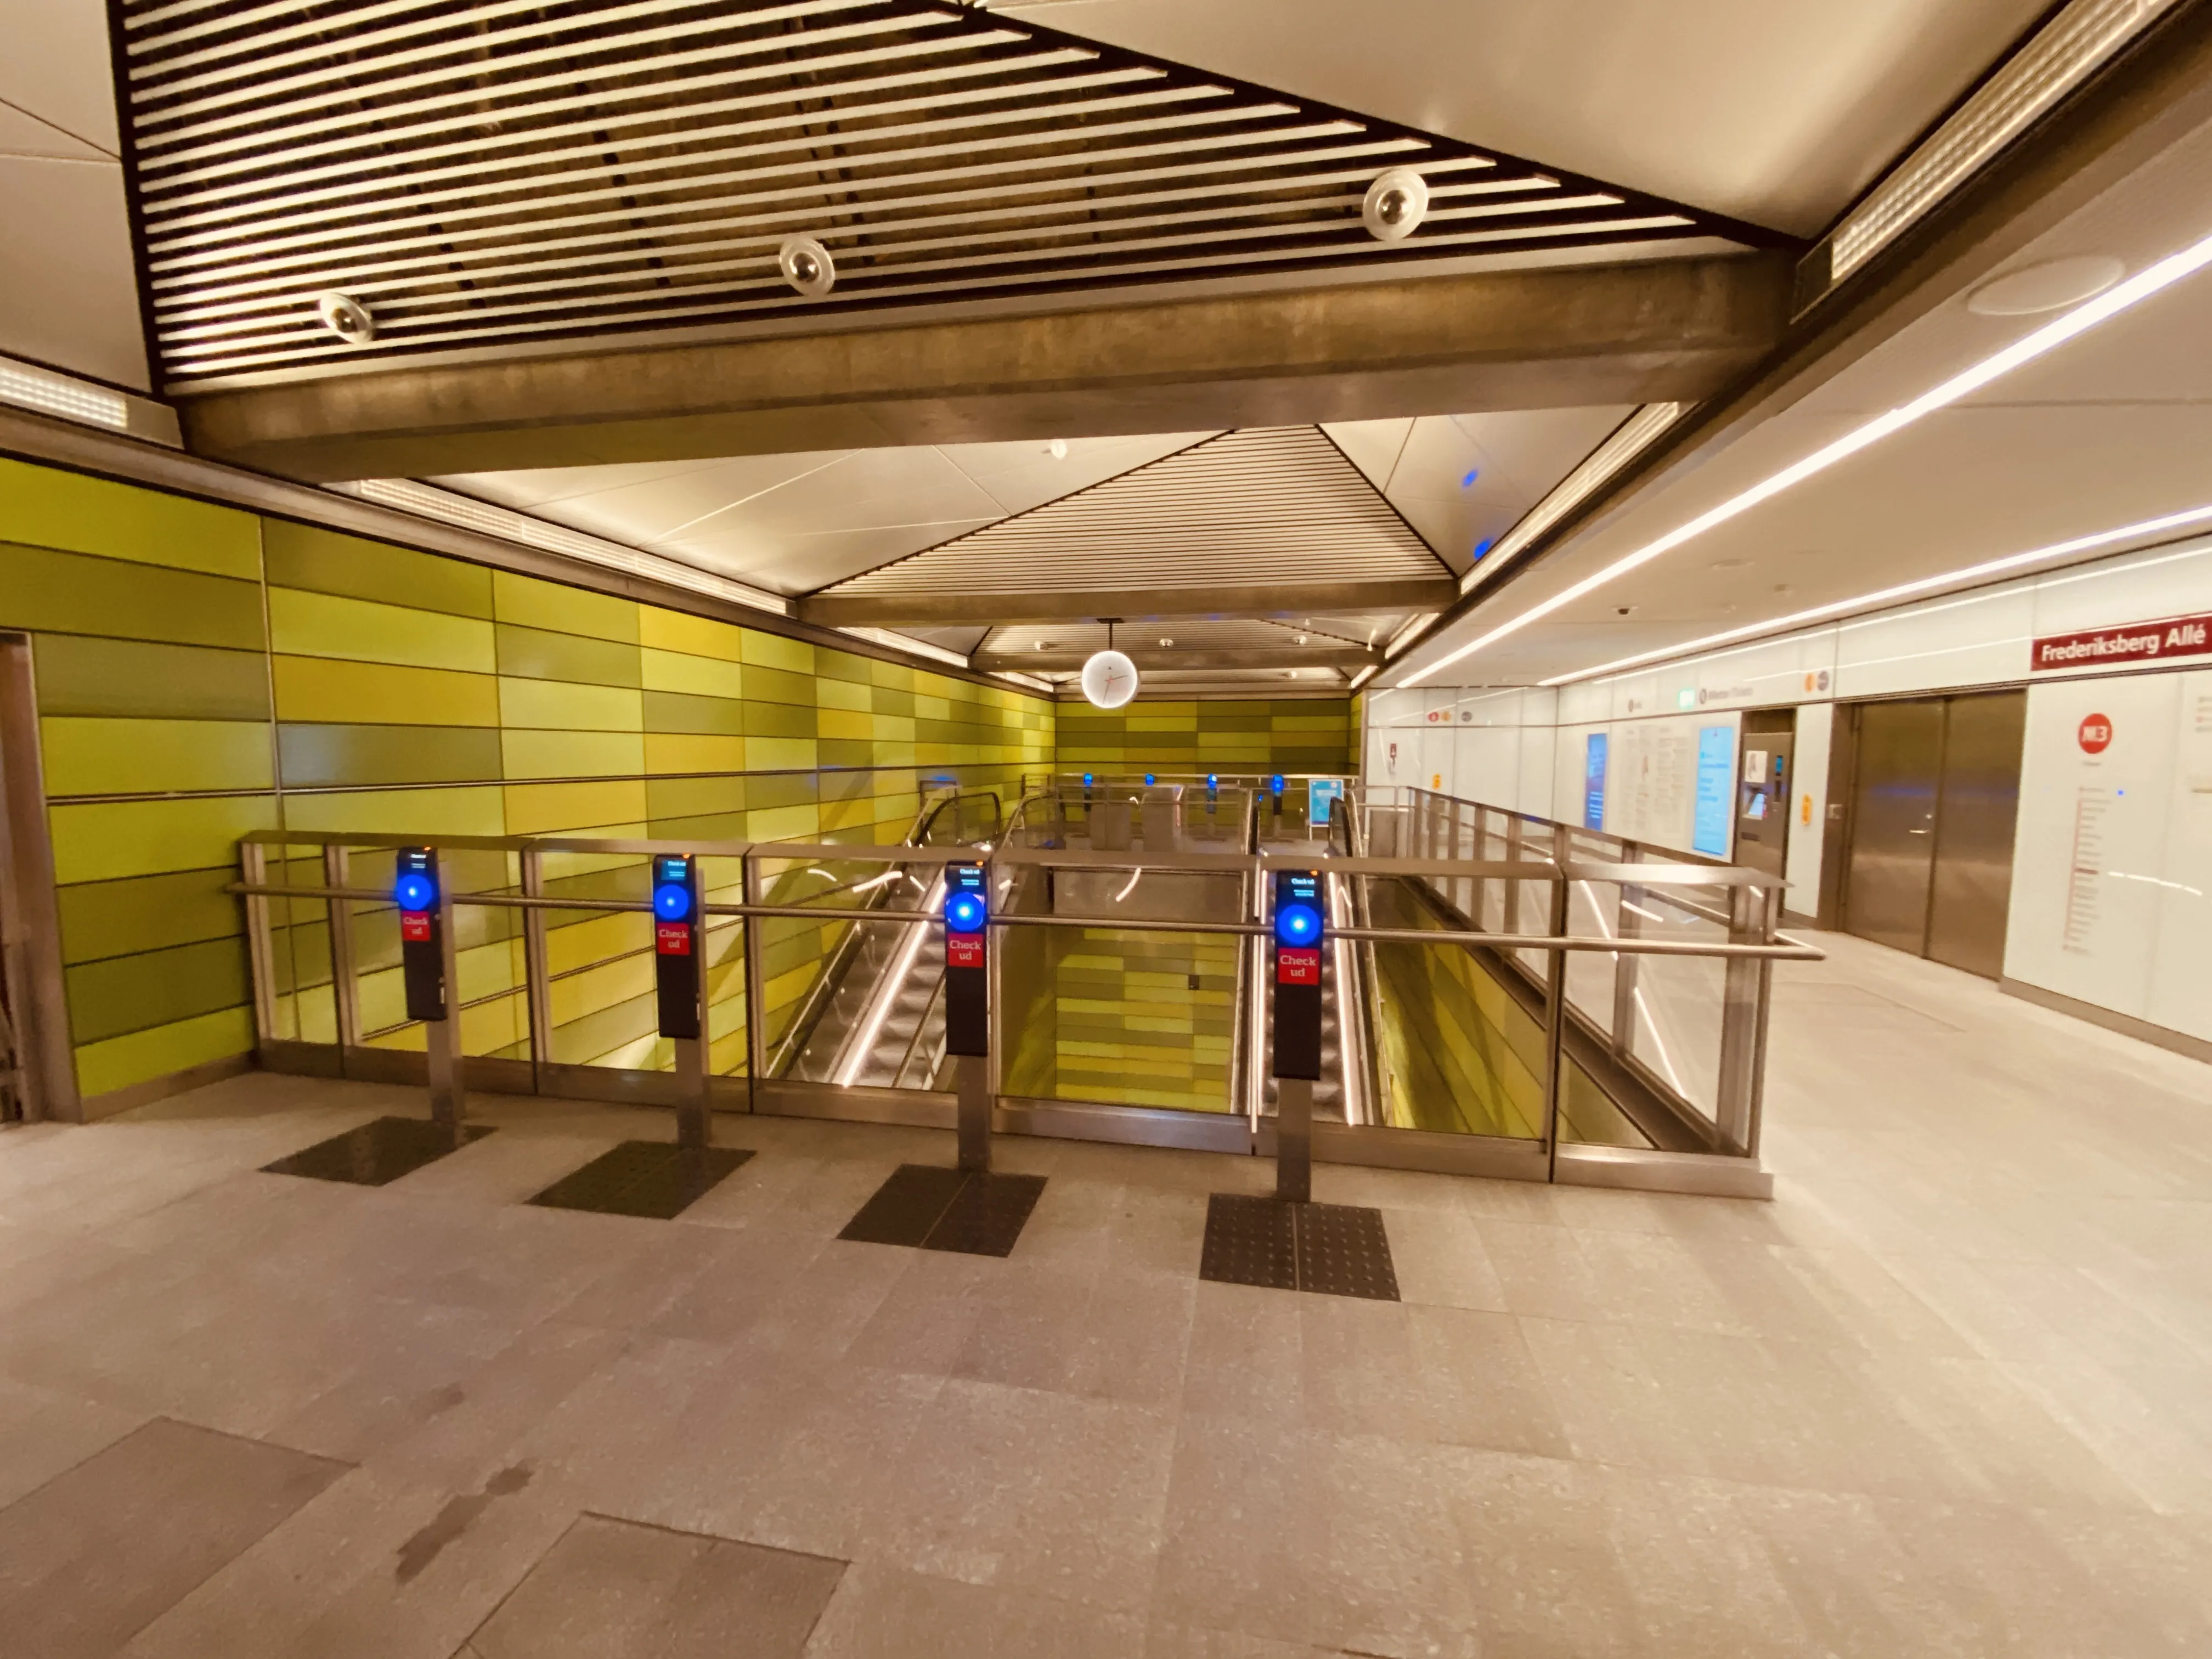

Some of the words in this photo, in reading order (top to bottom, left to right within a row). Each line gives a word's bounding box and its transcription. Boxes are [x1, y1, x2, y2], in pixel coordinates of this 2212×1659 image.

[2041, 634, 2160, 662] Frederiksberg
[2165, 623, 2207, 647] Allé
[659, 929, 688, 939] Check
[667, 940, 680, 949] ud
[949, 940, 981, 950] Check
[958, 951, 972, 961] ud
[1280, 954, 1316, 966] Check
[1290, 968, 1305, 977] ud
